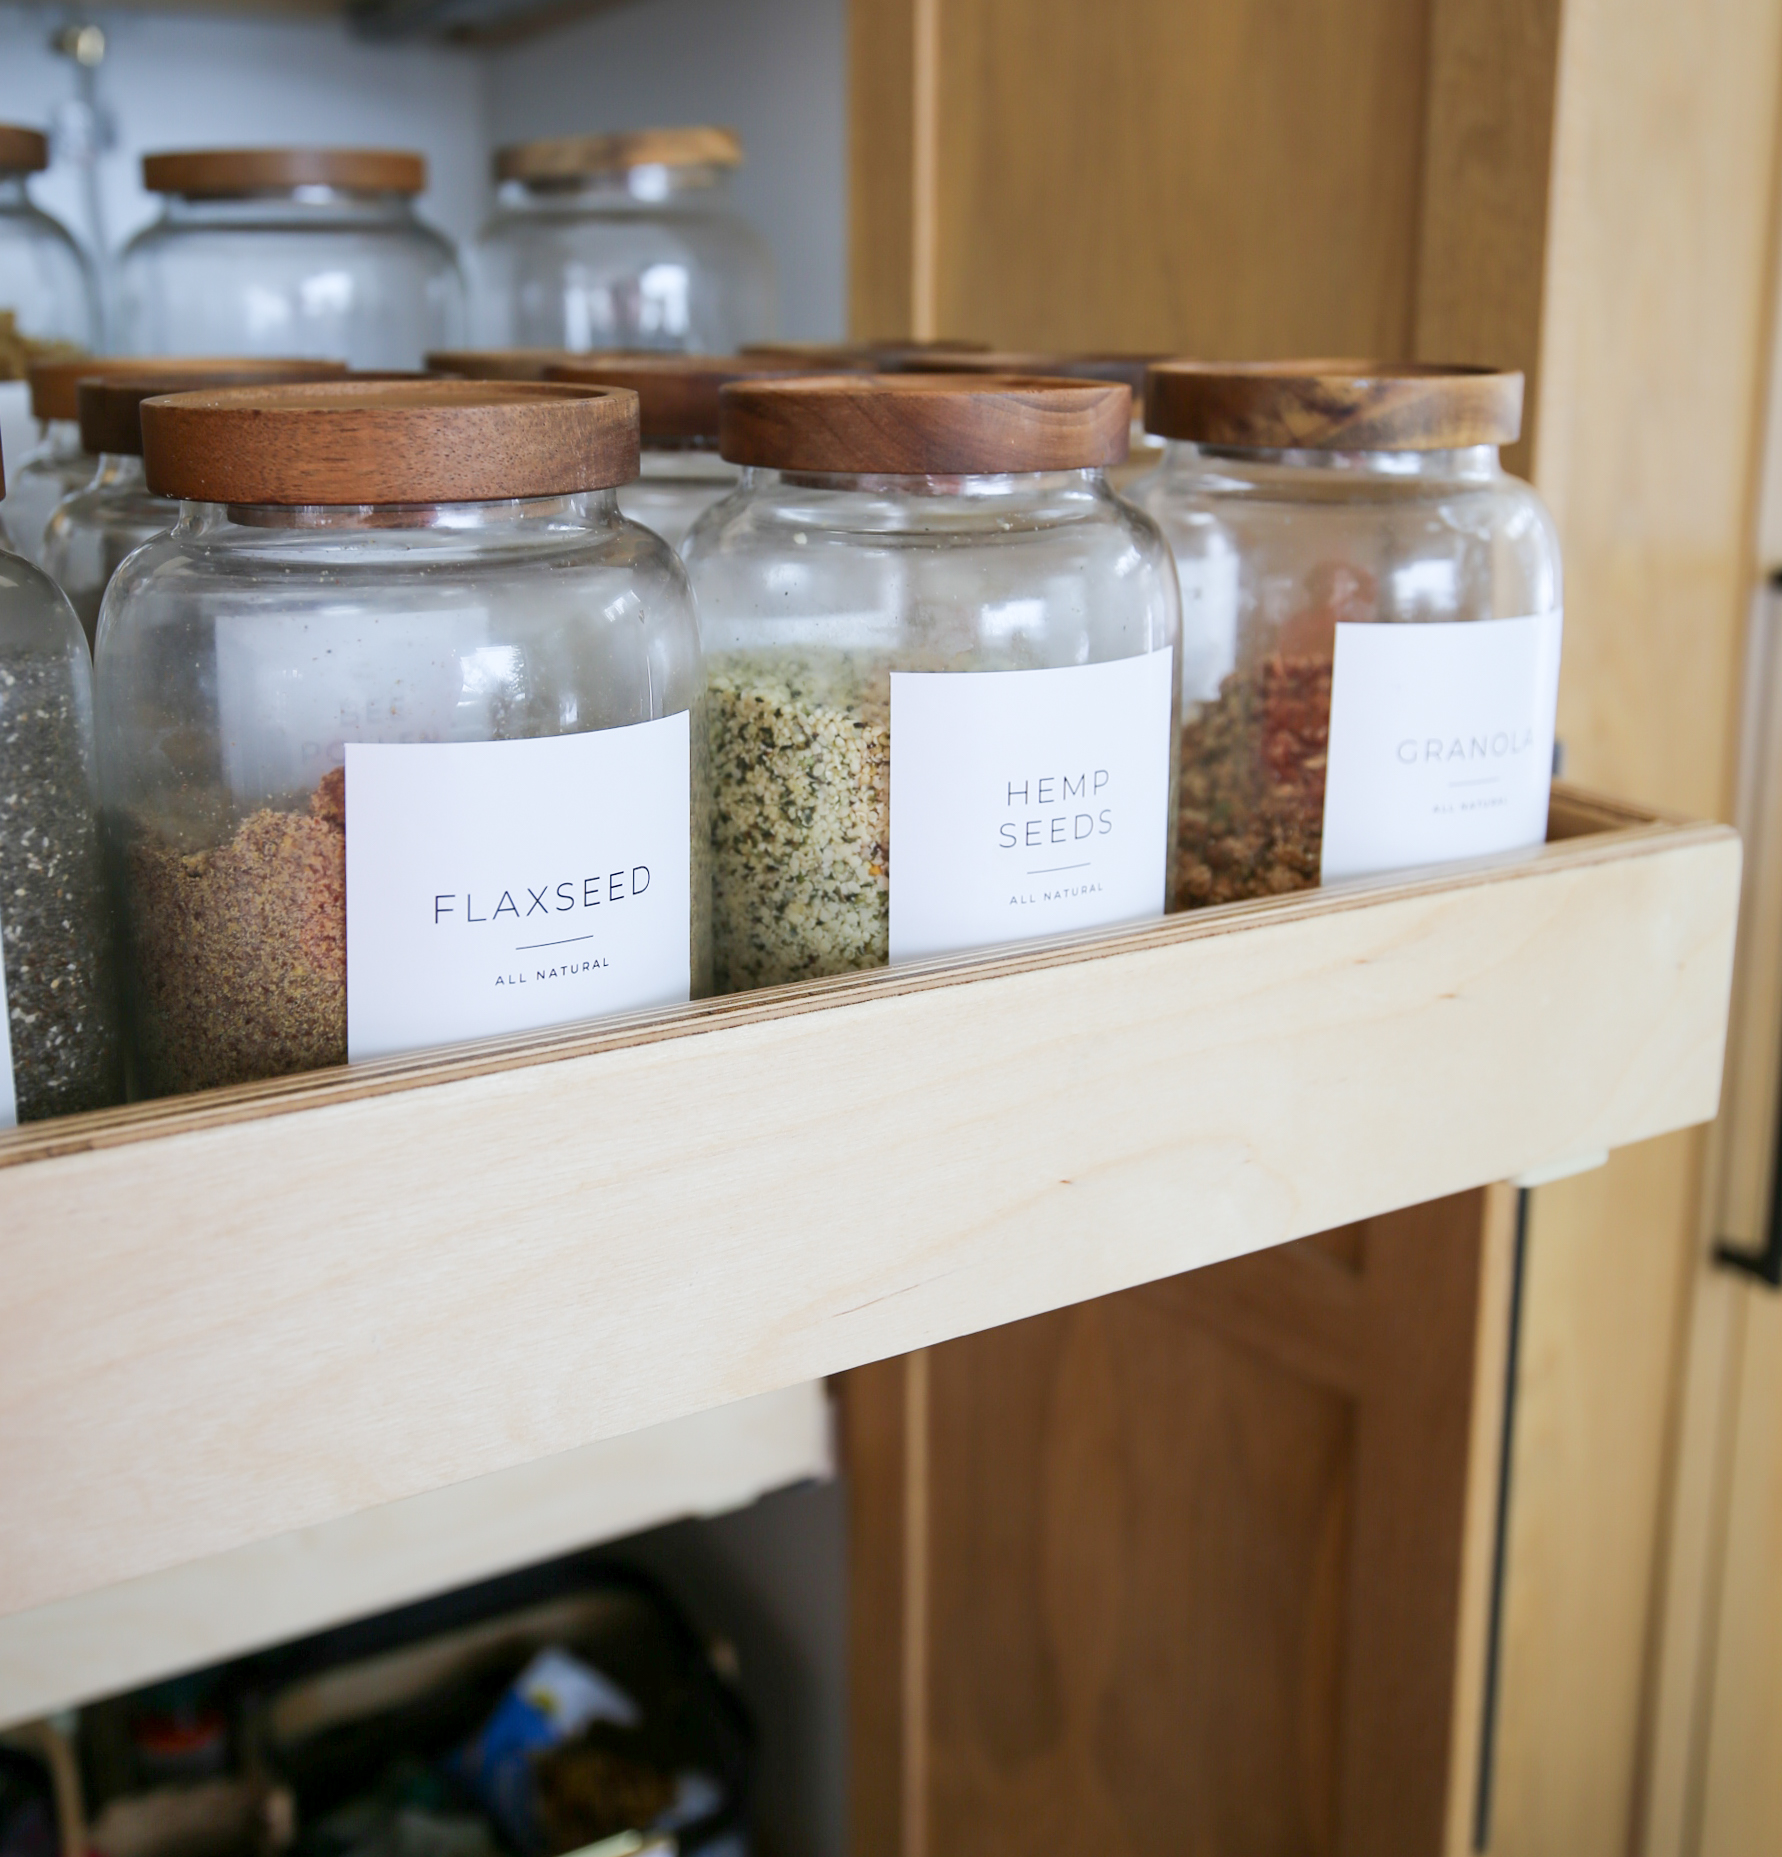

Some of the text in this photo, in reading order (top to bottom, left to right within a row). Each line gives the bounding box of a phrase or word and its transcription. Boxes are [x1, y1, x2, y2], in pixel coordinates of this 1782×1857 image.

[1396, 727, 1534, 765] GRANOLA
[1007, 769, 1110, 807] HEMP
[998, 808, 1113, 849] SEEDS
[434, 865, 651, 925] FLAXSEED
[1008, 882, 1103, 906] ALL NATURAL
[494, 957, 610, 987] ALL NATURAL
